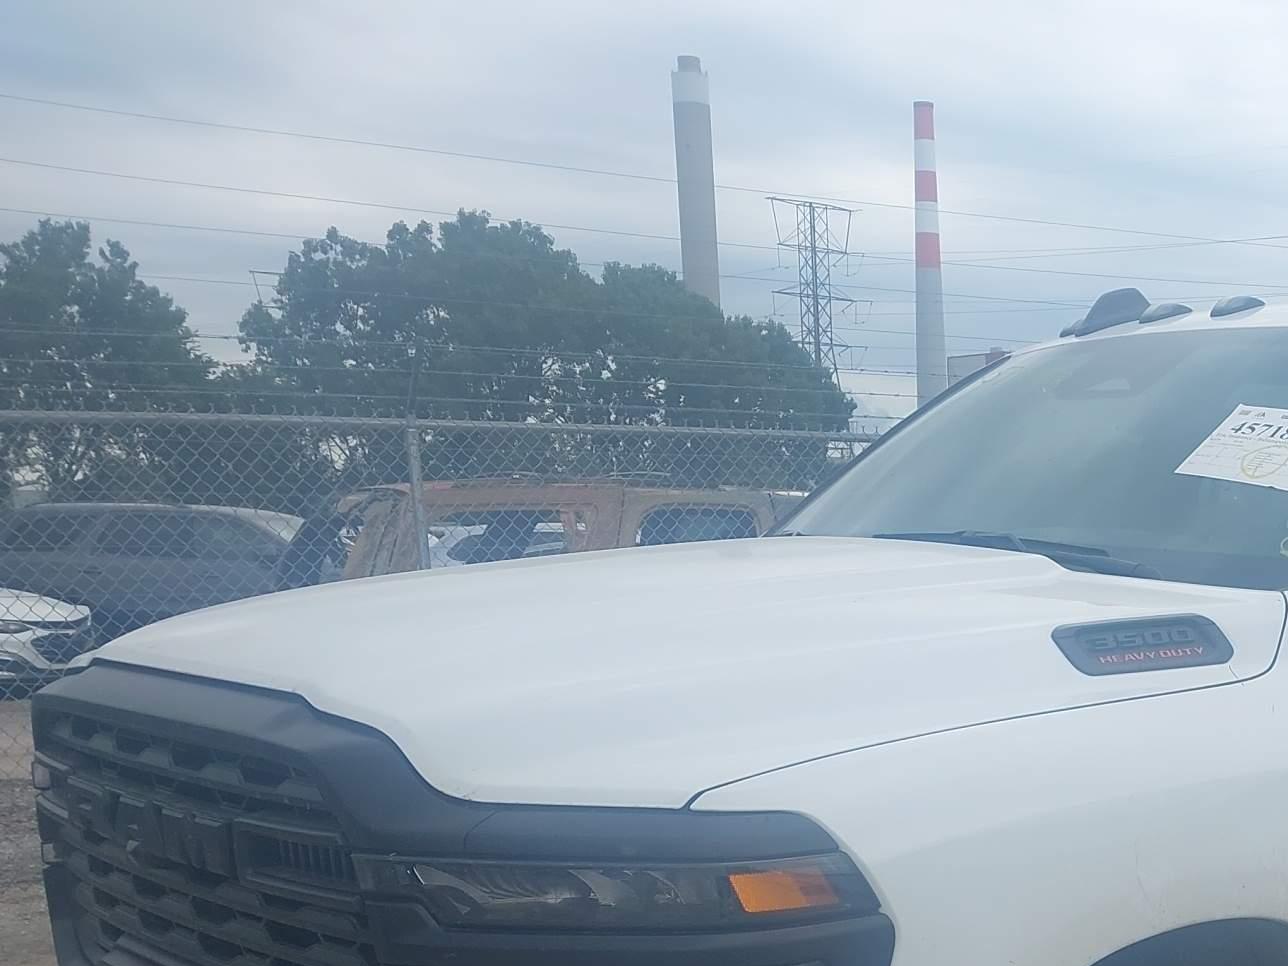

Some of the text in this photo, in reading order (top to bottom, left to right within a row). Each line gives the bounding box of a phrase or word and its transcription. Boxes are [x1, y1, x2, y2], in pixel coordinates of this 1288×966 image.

[1089, 626, 1194, 649] 3500
[1099, 647, 1204, 664] HEAVY DUTY
